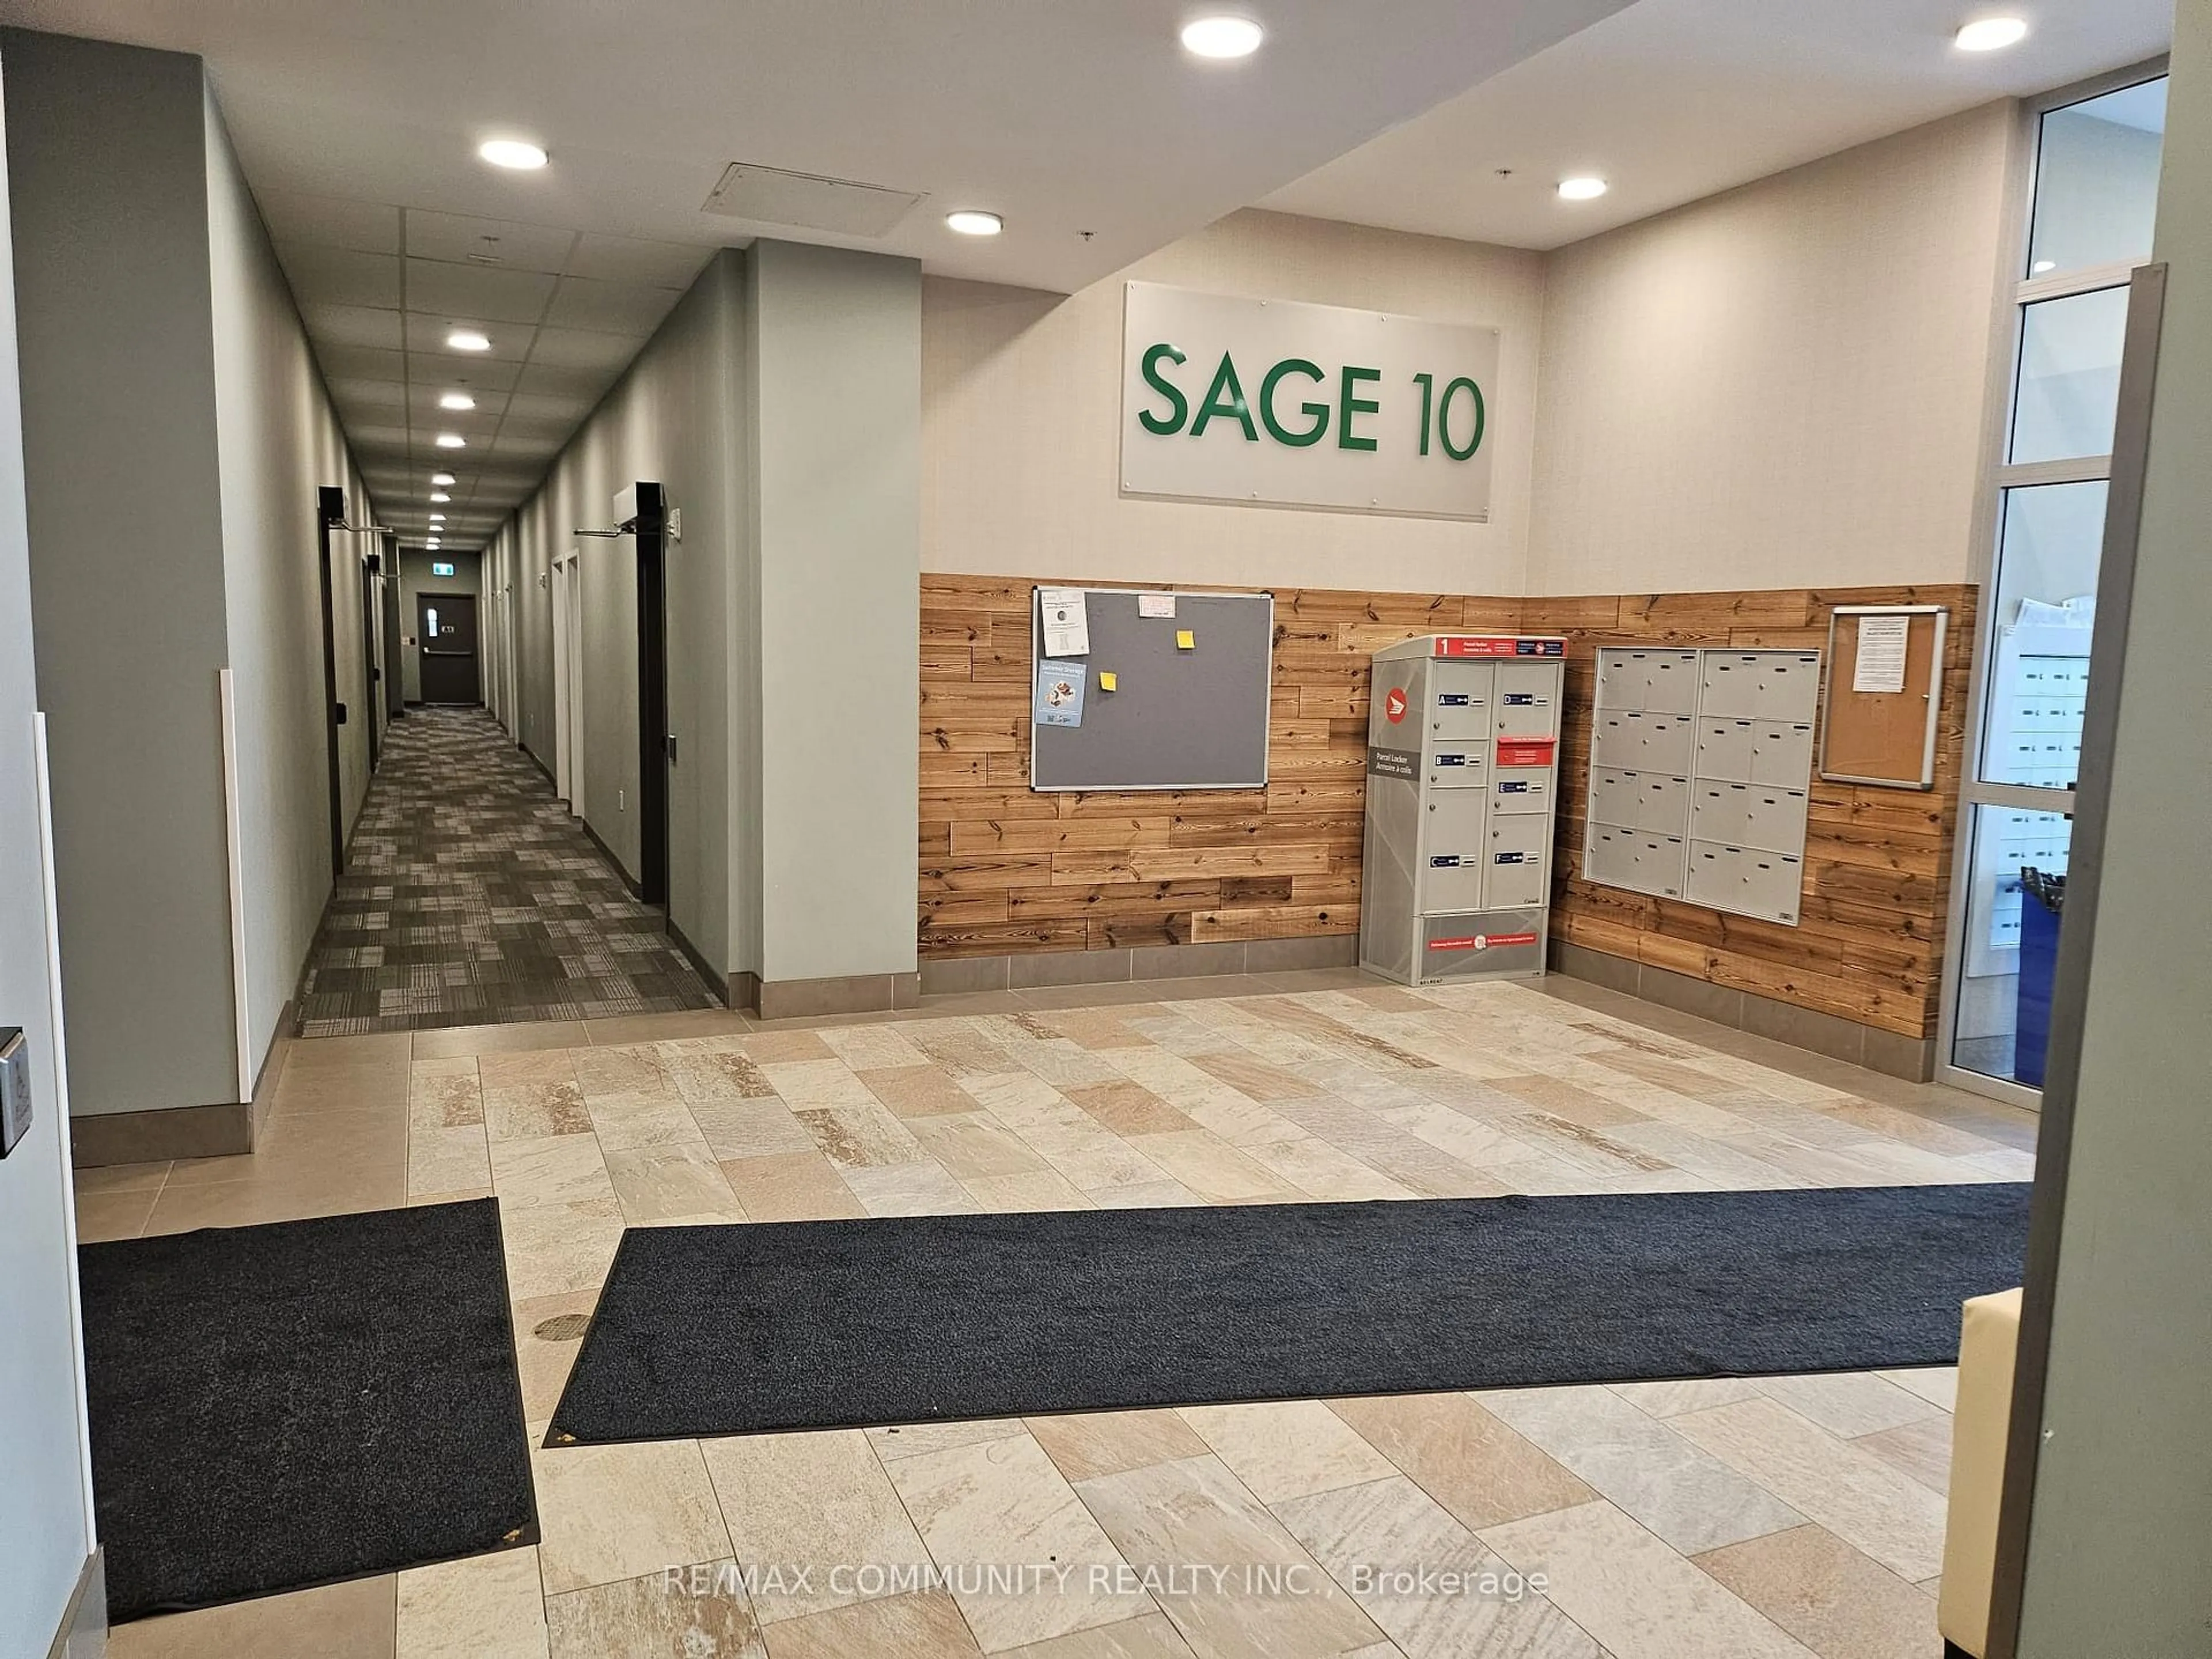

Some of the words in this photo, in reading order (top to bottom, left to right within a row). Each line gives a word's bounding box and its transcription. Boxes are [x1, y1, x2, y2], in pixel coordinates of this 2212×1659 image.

[1138, 343, 1381, 452] SAGE
[1413, 373, 1485, 461] 10
[1441, 638, 1448, 655] 1
[1440, 695, 1446, 704] A
[1505, 695, 1512, 704] D
[1436, 756, 1442, 764] B
[1500, 783, 1506, 792] E
